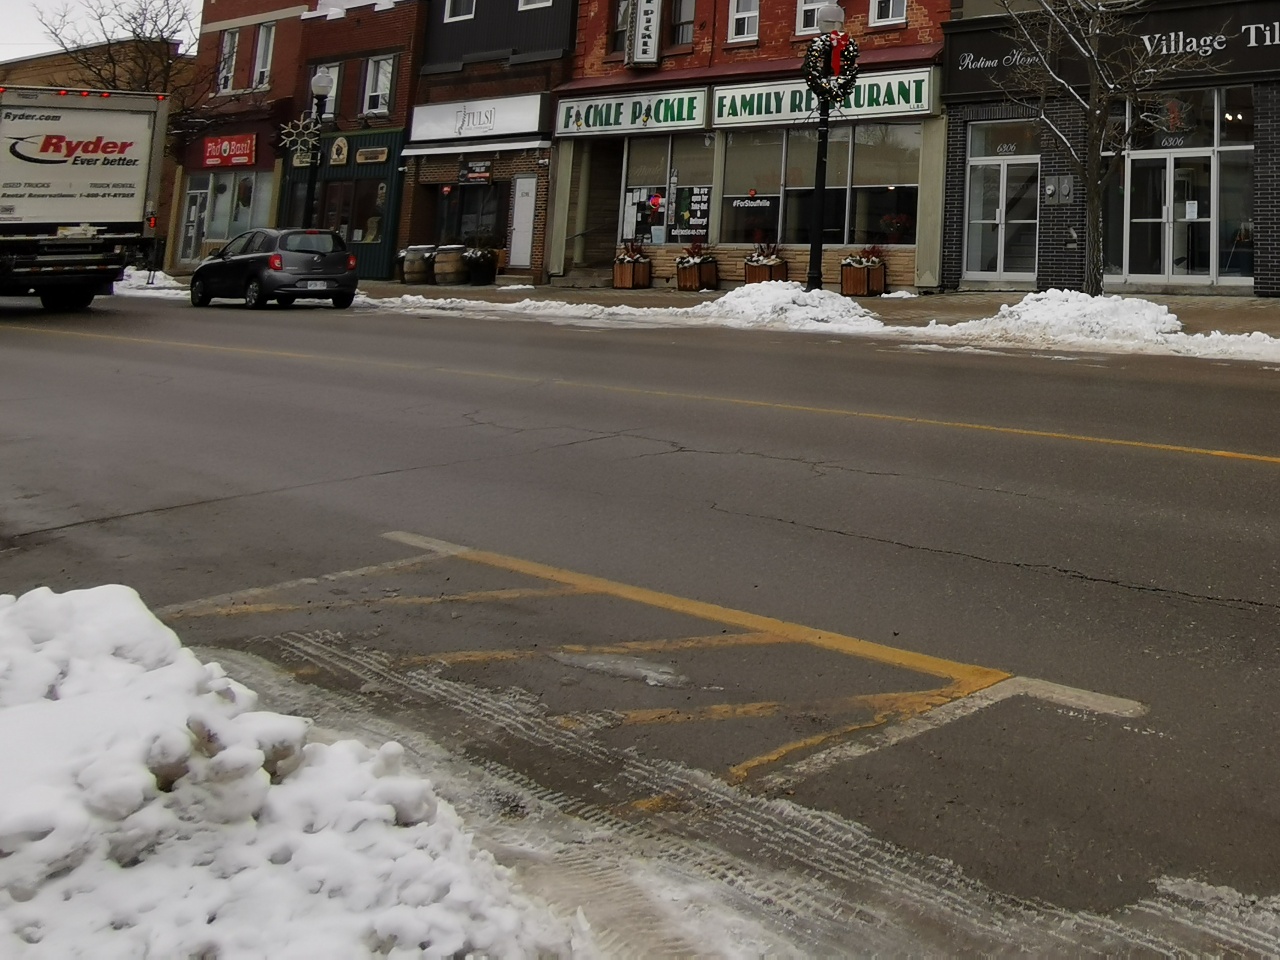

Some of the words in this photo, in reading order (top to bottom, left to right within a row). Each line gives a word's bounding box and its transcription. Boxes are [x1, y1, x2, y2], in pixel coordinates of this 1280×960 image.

[1140, 31, 1226, 57] Village
[718, 89, 785, 118] FAMILY
[790, 79, 925, 113] REAURANT
[4, 112, 62, 122] Ryder.com
[466, 109, 493, 127] TULSI
[39, 134, 134, 158] Ryder
[230, 139, 251, 155] Basil
[71, 156, 99, 166] Ever
